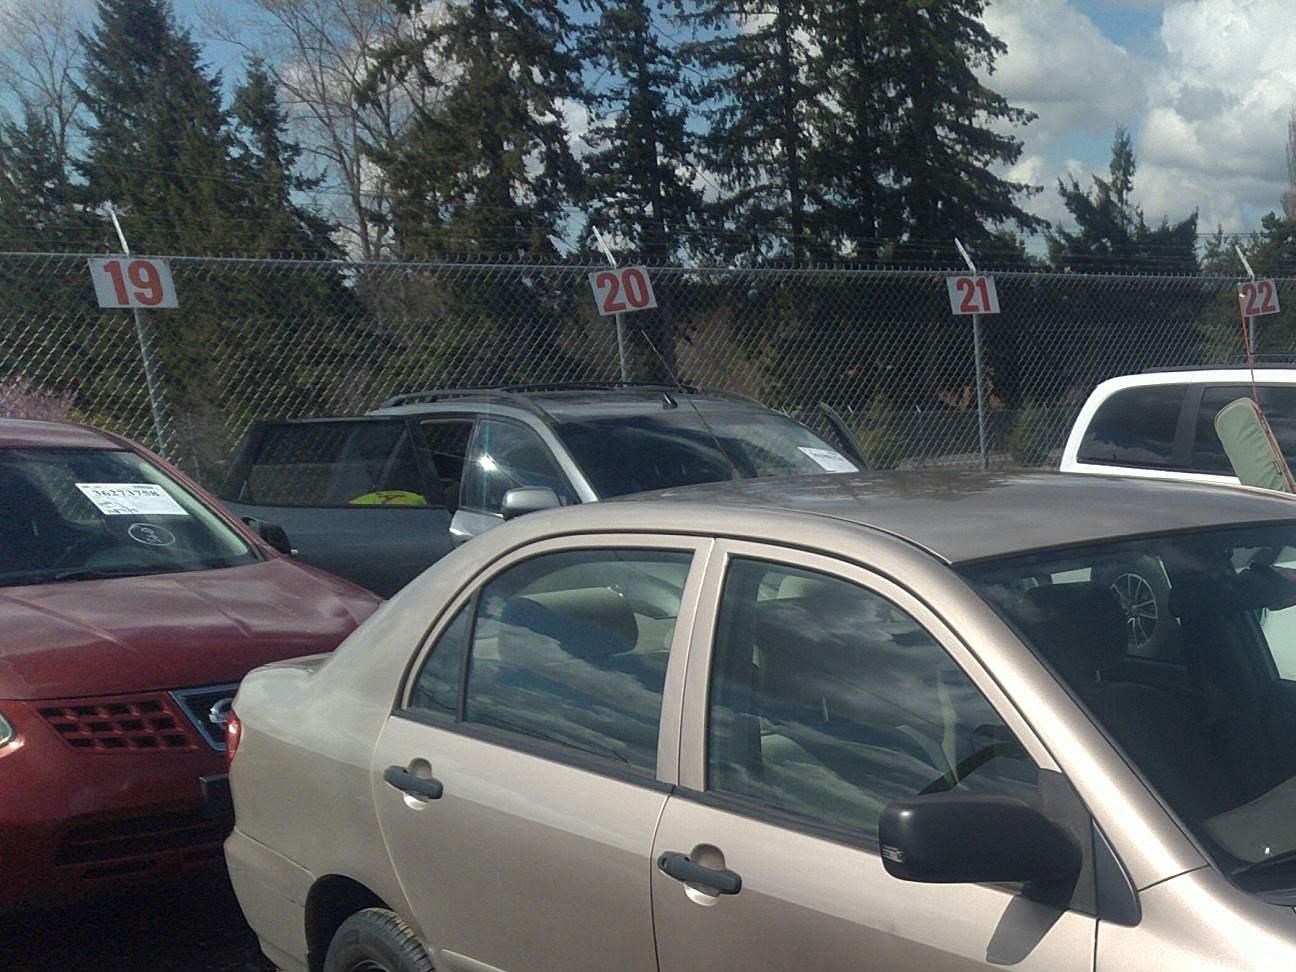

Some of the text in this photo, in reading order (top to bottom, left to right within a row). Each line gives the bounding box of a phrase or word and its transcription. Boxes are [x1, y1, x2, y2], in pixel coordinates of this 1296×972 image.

[103, 259, 164, 306] 19
[595, 267, 650, 312] 20
[956, 276, 991, 313] 21
[1242, 281, 1276, 315] 22
